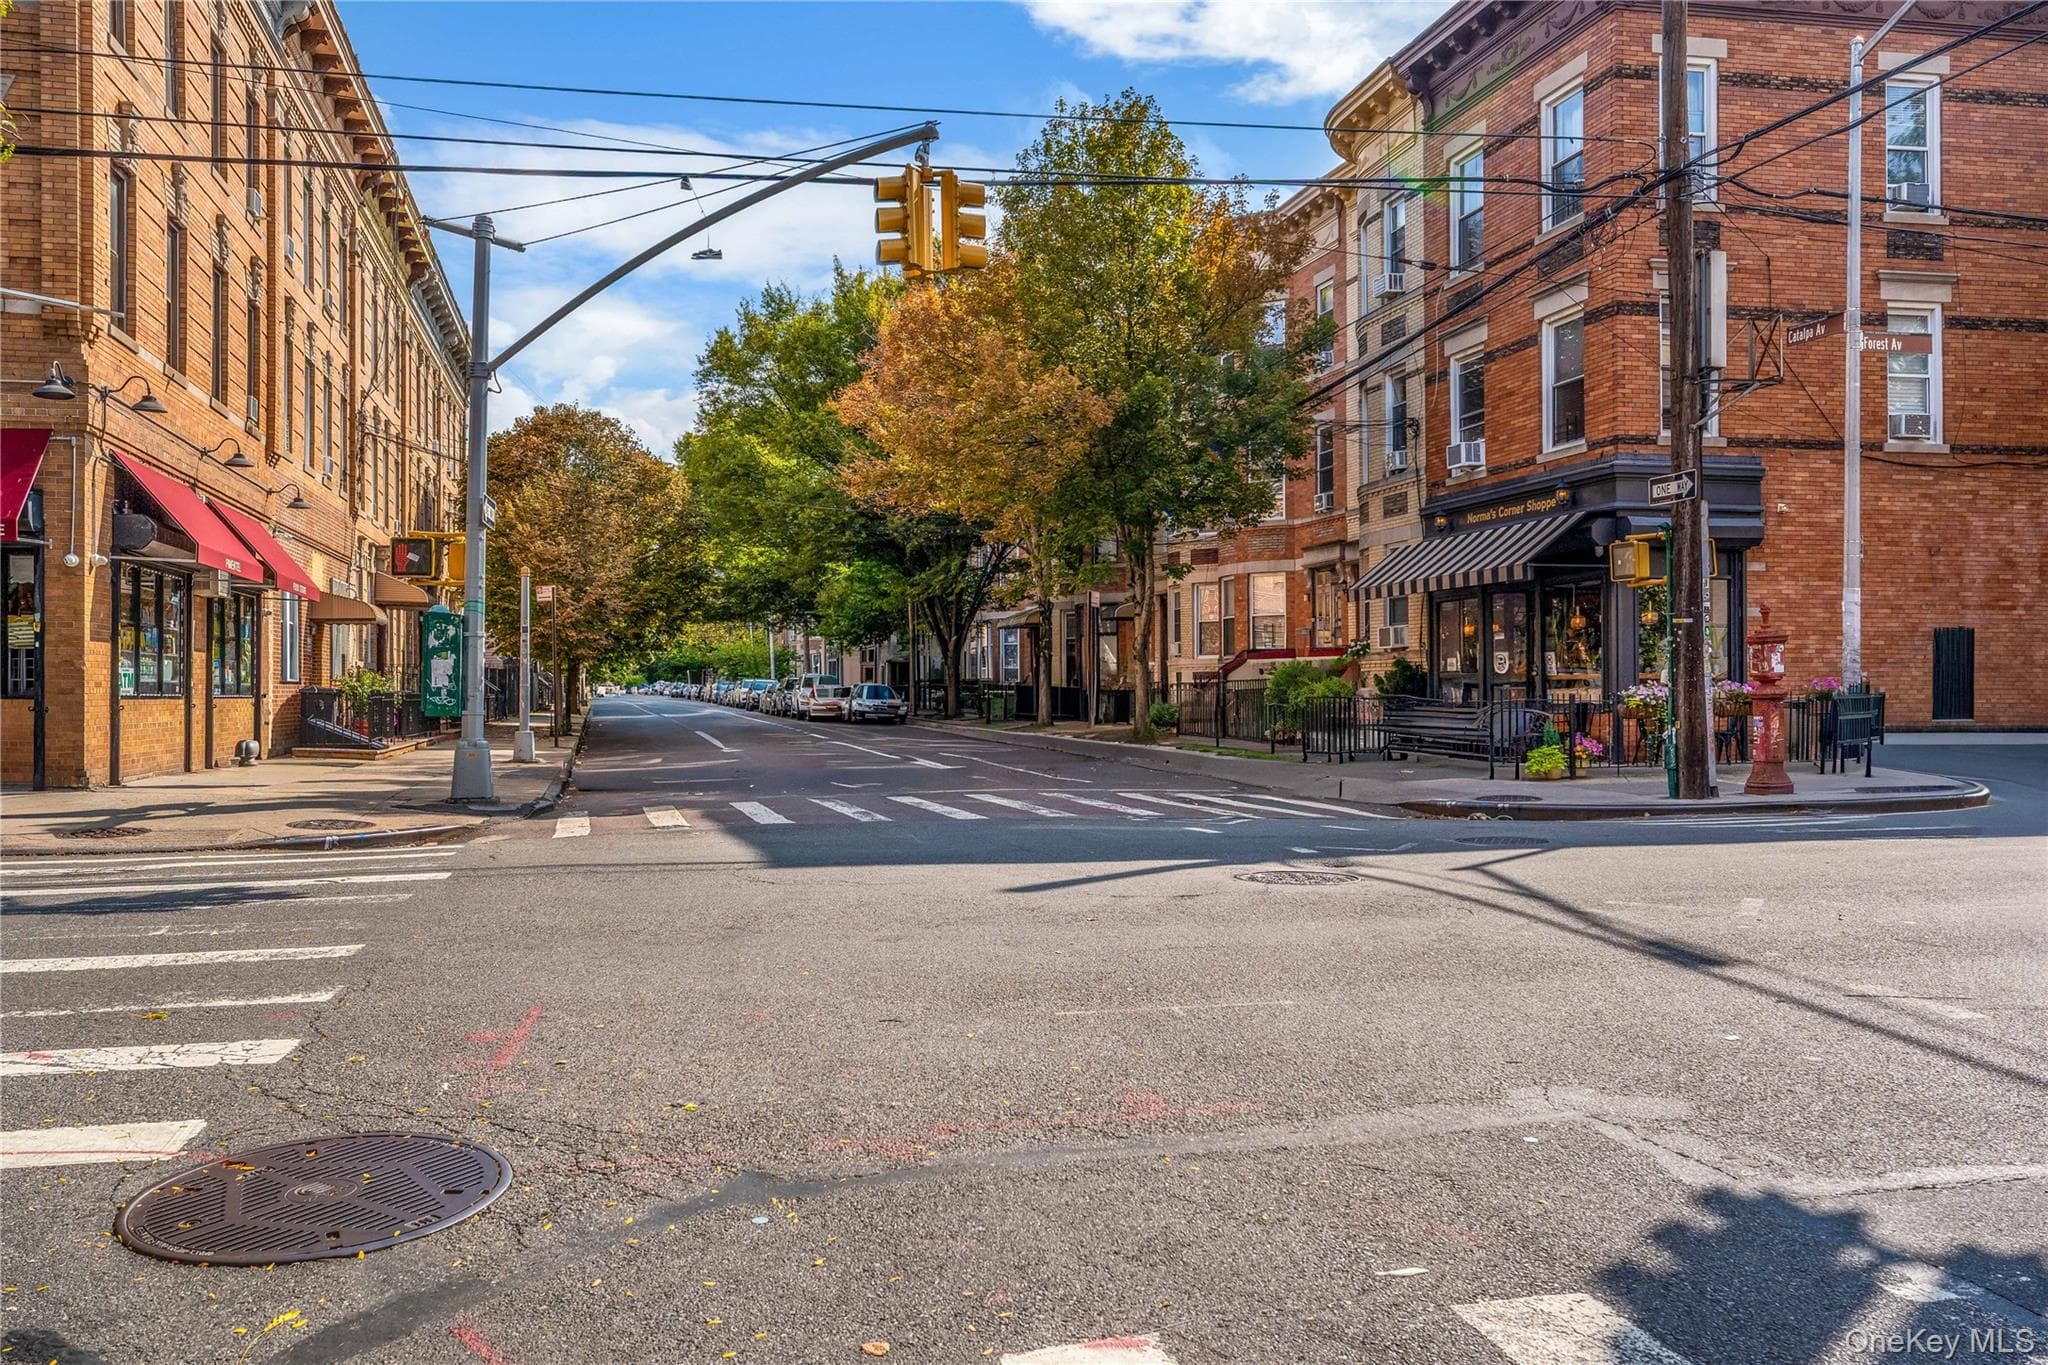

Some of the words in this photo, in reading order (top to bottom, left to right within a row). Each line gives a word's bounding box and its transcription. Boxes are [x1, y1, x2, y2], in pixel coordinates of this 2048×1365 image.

[1788, 327, 1814, 344] Catalpa
[1815, 324, 1825, 336] Av
[1863, 337, 1888, 351] Forest
[1891, 338, 1902, 351] Av
[1656, 483, 1671, 496] ONE
[1467, 508, 1497, 524] Norma's
[1498, 504, 1525, 518] Corner
[1526, 498, 1557, 512] Shoppe
